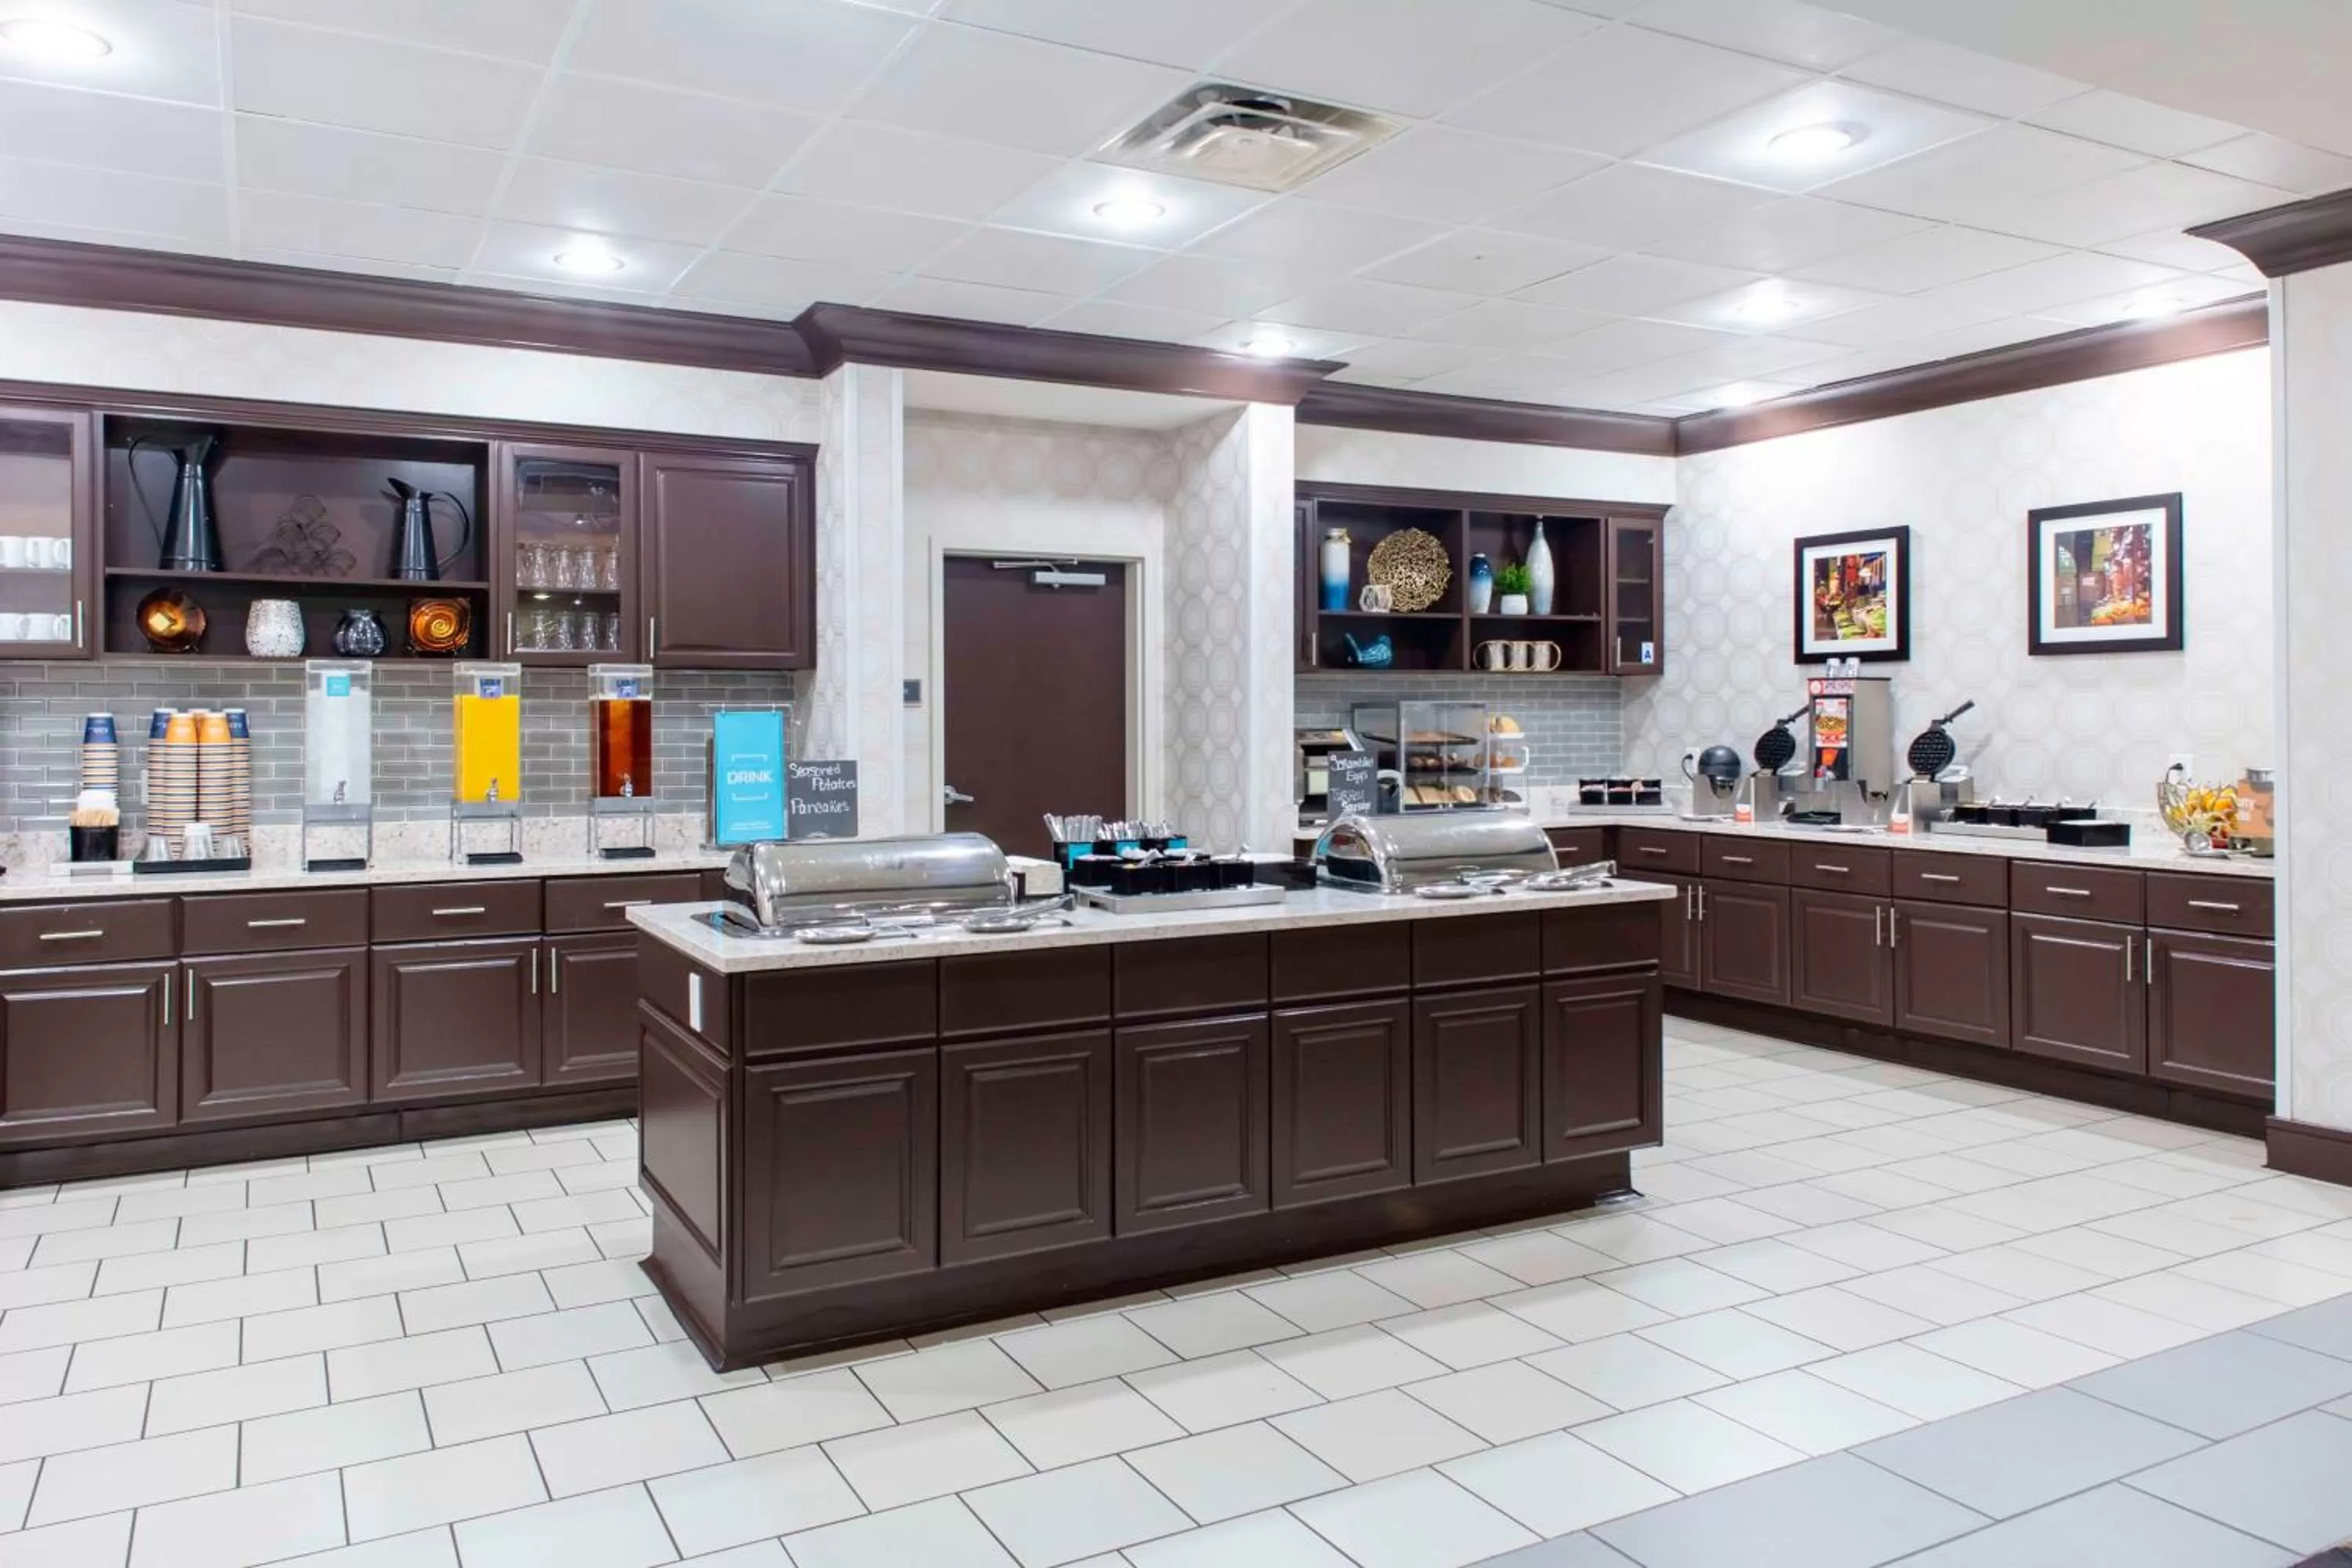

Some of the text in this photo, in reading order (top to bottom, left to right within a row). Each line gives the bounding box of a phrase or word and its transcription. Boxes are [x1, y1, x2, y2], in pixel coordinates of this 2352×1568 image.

[727, 769, 774, 785] DRINK
[789, 762, 841, 779] Seasoned
[811, 777, 856, 791] Potatoes
[790, 797, 850, 815] Pancakes
